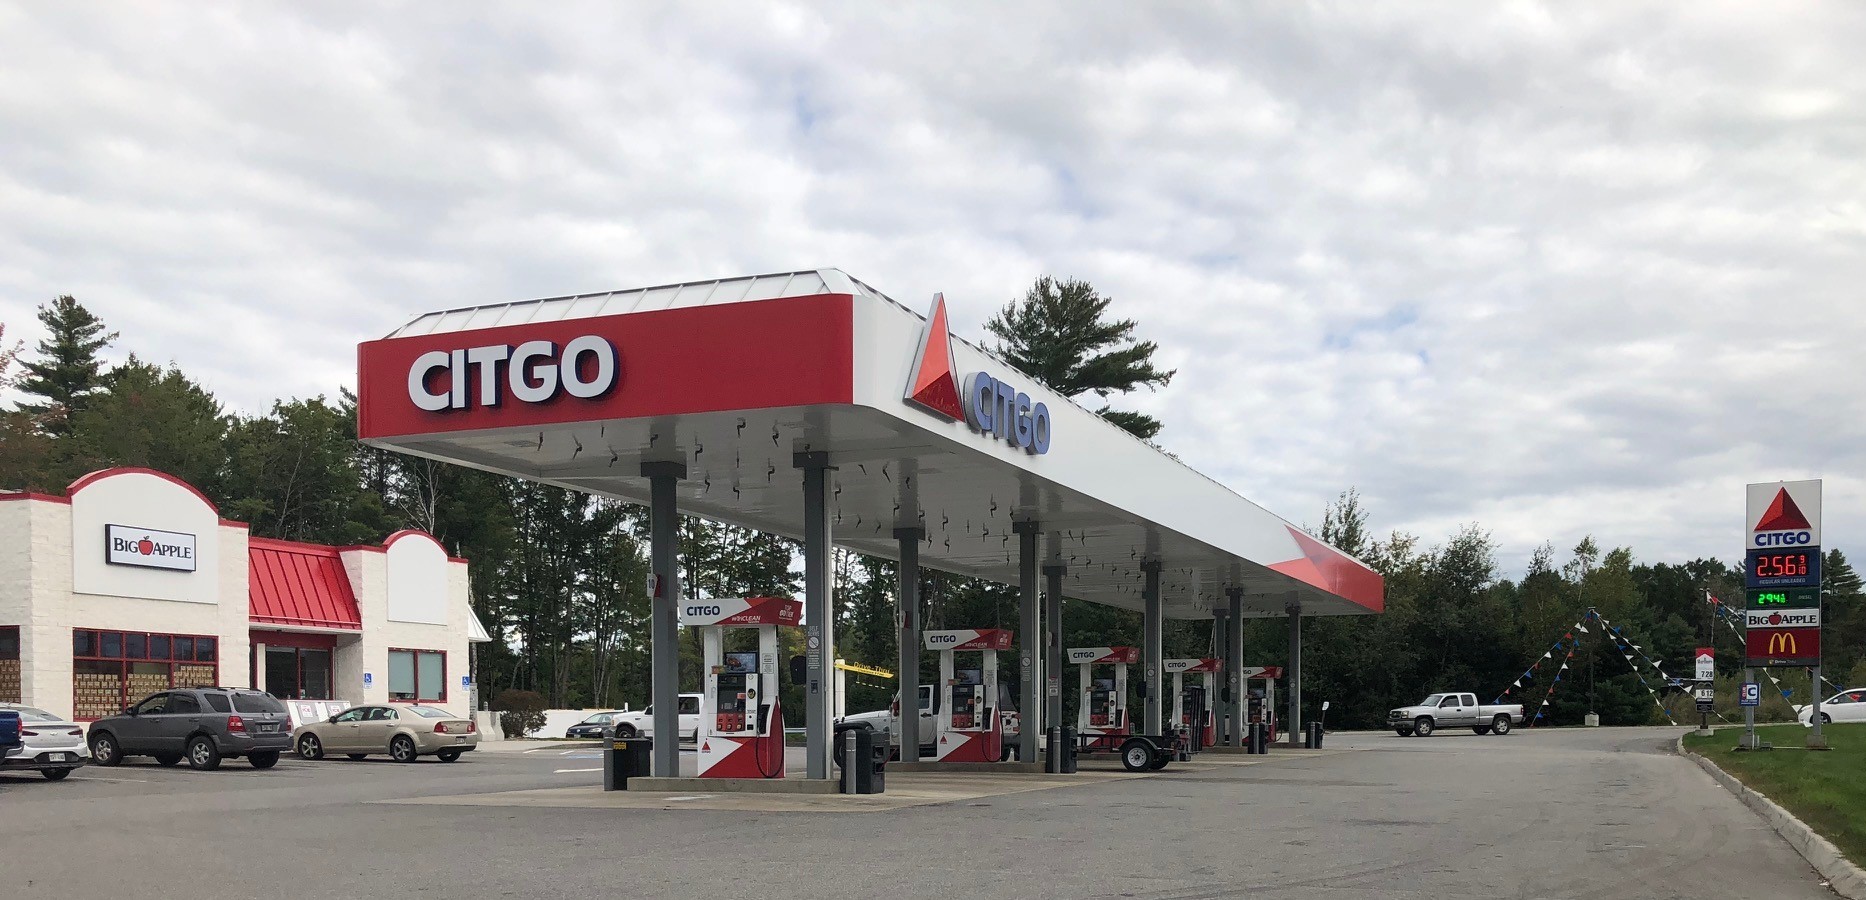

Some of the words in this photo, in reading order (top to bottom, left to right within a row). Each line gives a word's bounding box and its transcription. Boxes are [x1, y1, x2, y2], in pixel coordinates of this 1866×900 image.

[408, 335, 617, 412] CITGO
[965, 371, 1051, 455] CITGO
[1754, 531, 1811, 547] CITGO
[113, 537, 138, 553] BIG
[152, 542, 192, 559] APPLE
[1757, 555, 1796, 576] 2.56
[686, 605, 721, 616] CITGO
[1748, 615, 1769, 625] BIG
[1780, 614, 1817, 624] APPLE
[930, 635, 957, 644] CITGO
[1072, 651, 1095, 659] CITGO
[1167, 661, 1187, 669] CITGO
